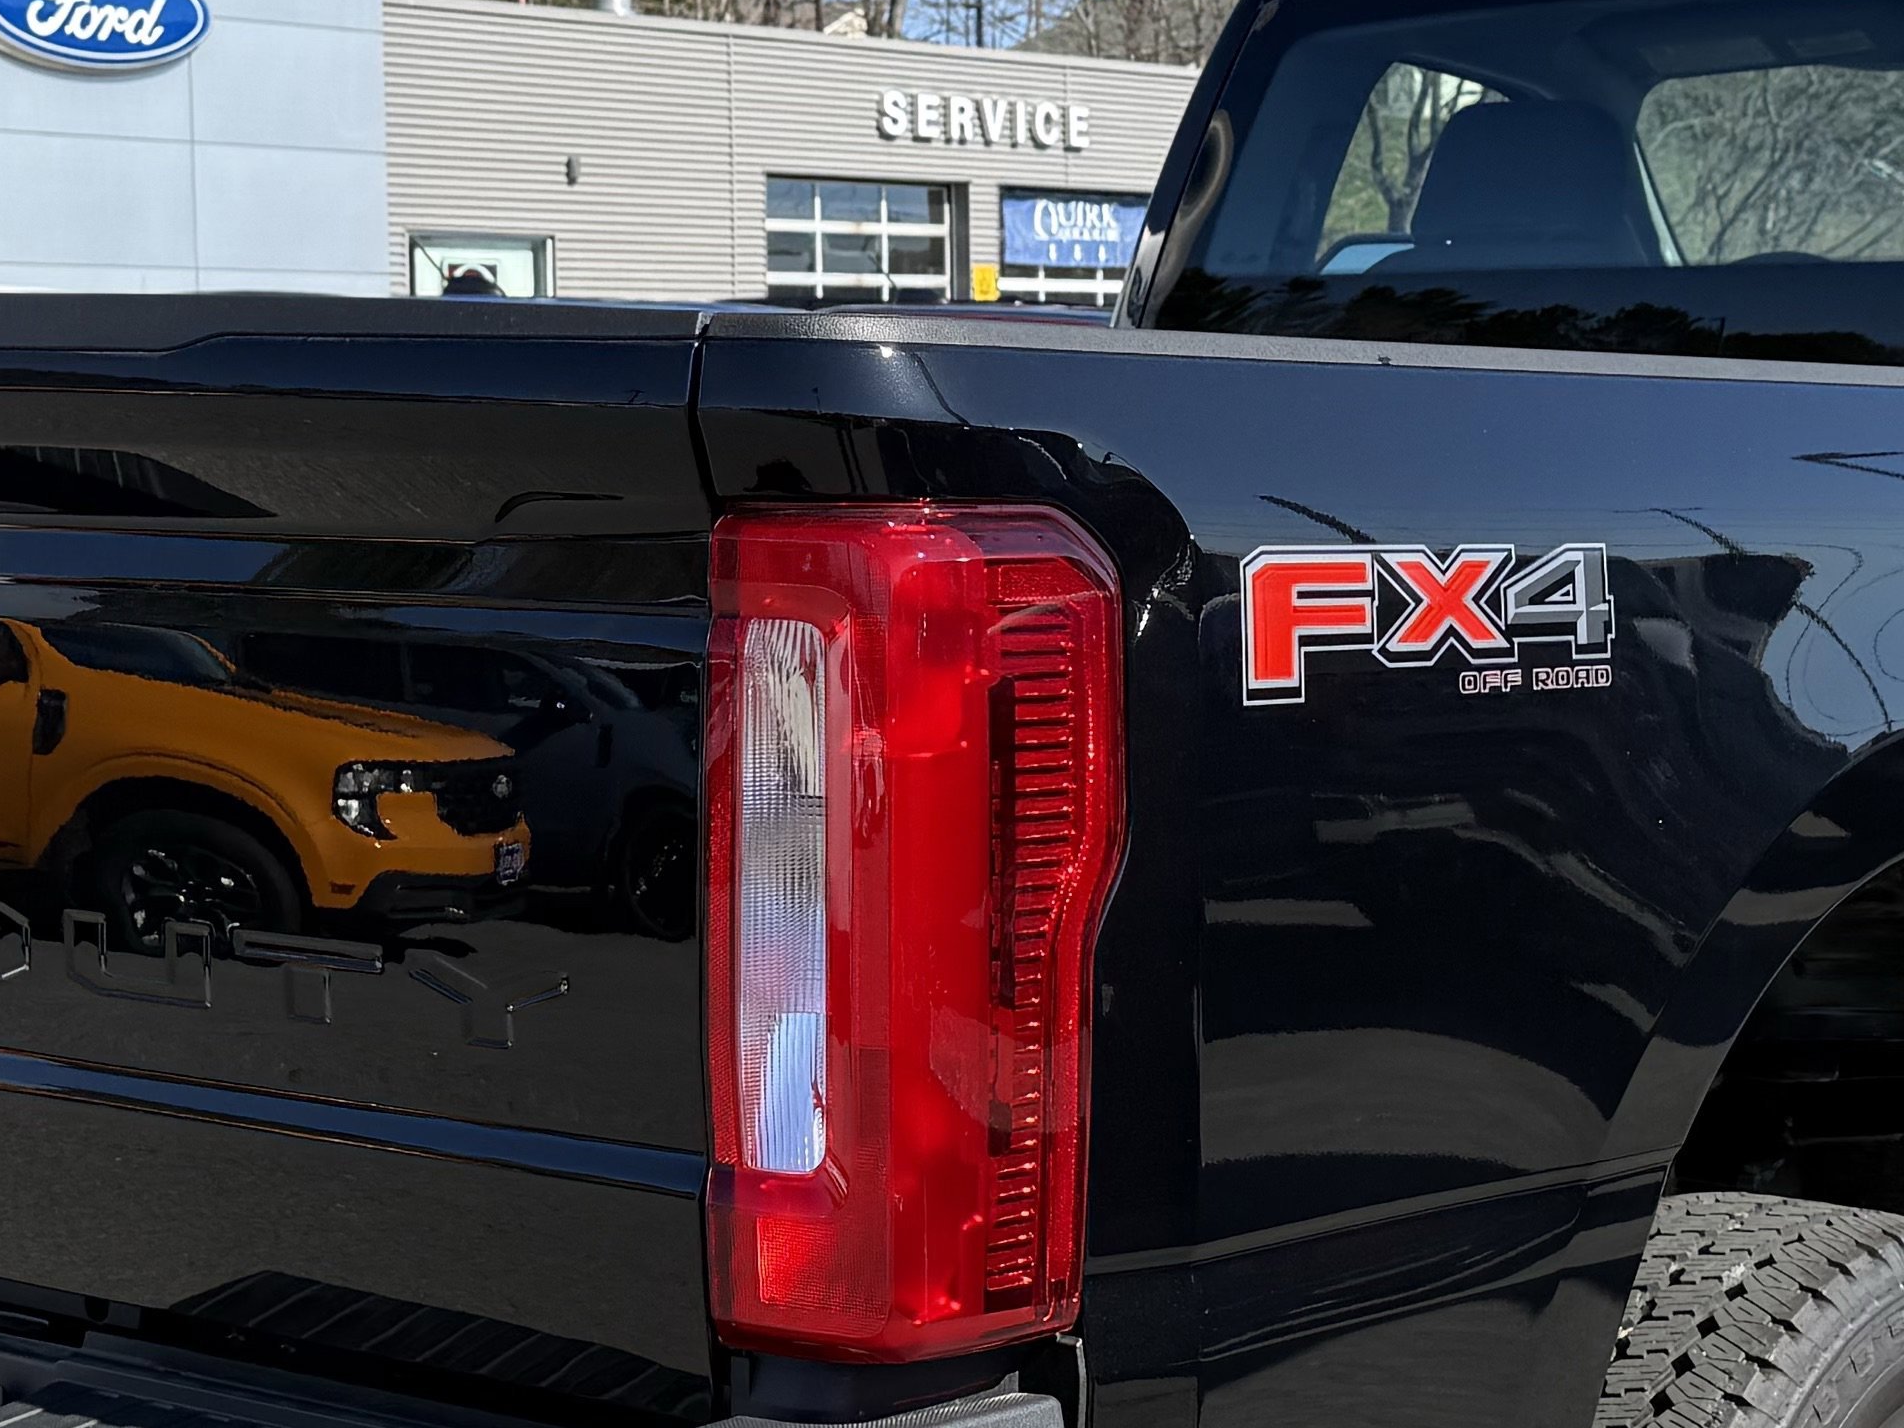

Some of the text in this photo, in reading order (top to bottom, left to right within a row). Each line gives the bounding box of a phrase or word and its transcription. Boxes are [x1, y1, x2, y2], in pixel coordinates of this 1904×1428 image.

[879, 89, 1090, 148] SERVICE
[1239, 543, 1615, 707] FX4
[1459, 665, 1612, 694] OFF ROAD
